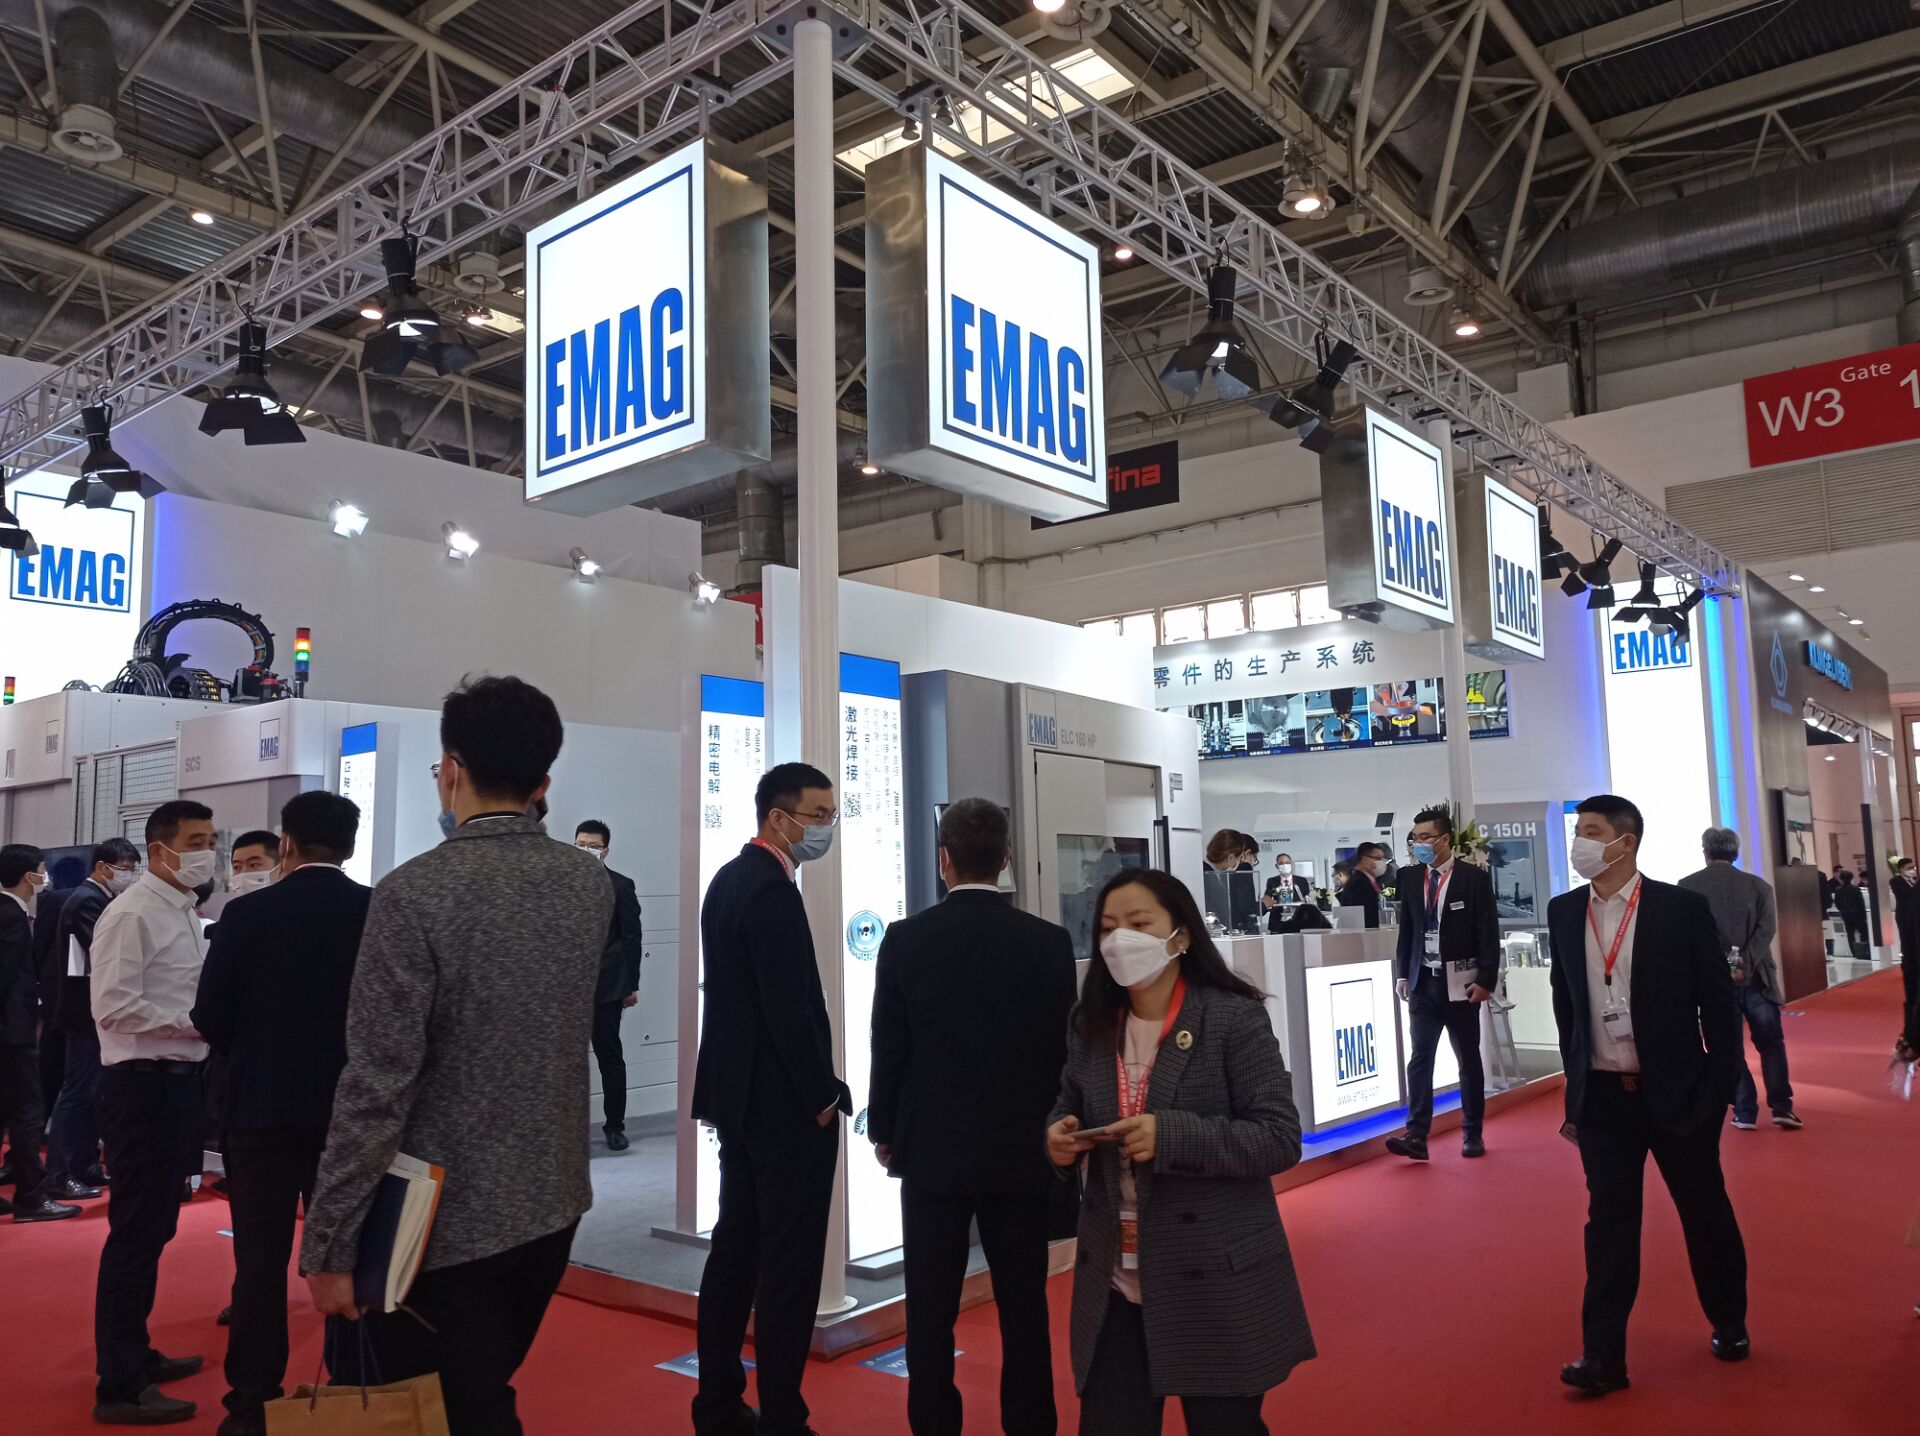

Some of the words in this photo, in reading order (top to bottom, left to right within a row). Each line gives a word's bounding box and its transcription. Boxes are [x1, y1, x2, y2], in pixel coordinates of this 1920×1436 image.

[546, 288, 683, 460] EMAG
[952, 295, 1087, 466] EMAG
[1758, 388, 1845, 437] W3
[1840, 363, 1892, 383] Gate
[18, 544, 125, 606] EMAG
[1381, 499, 1444, 600] EMAG
[1494, 554, 1538, 638] EMAG
[1153, 640, 1375, 689] 零件的生产系统
[46, 733, 58, 752] EMAG
[260, 736, 279, 759] EMAG
[708, 724, 721, 794] 精密电解
[845, 705, 858, 781] 激光焊接
[1028, 713, 1056, 746] EMAG
[1061, 729, 1075, 745] ELC
[1075, 732, 1087, 747] 160
[1087, 733, 1097, 748] HP
[185, 755, 201, 773] SCS
[1493, 823, 1522, 837] 150
[1525, 822, 1536, 836] H
[1336, 1022, 1376, 1080] EMAG
